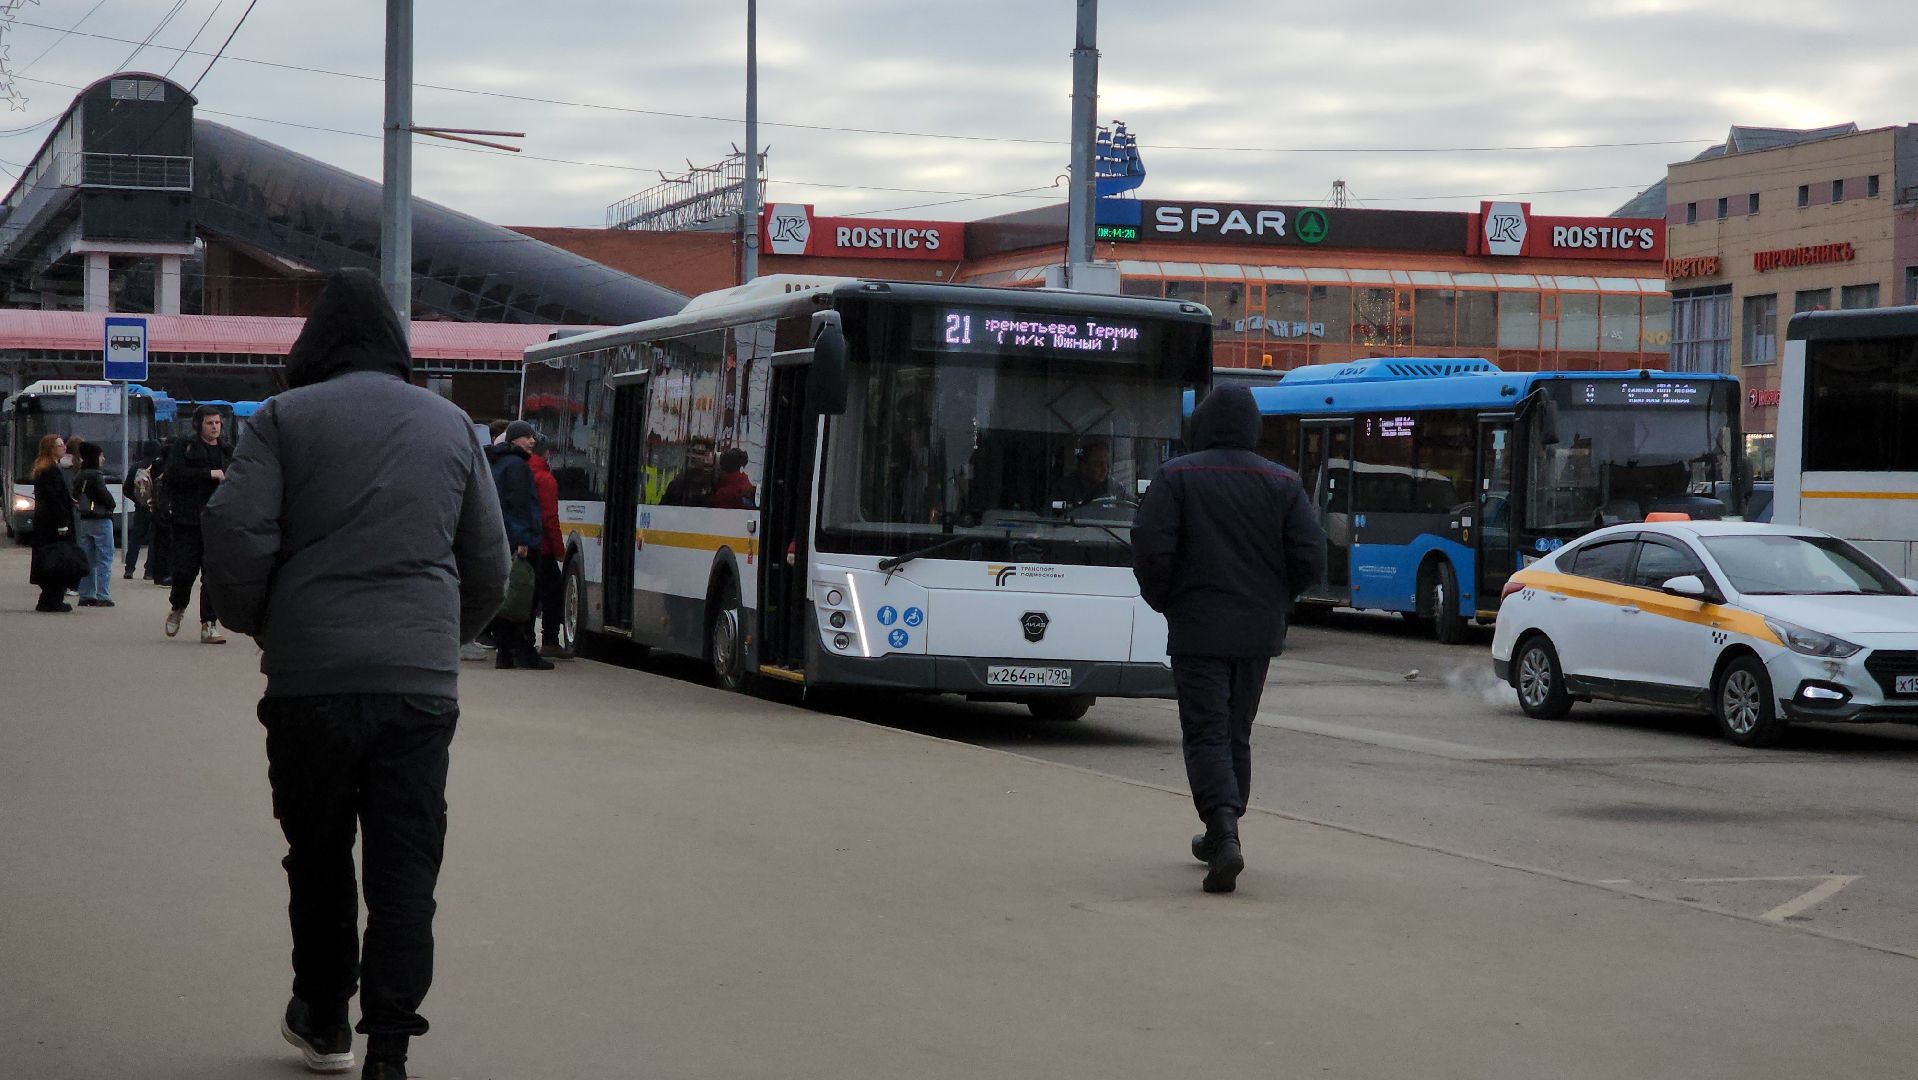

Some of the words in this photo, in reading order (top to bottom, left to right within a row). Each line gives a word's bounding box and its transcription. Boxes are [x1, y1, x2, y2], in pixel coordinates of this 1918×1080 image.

[1155, 206, 1286, 237] SPAR
[836, 226, 940, 250] ROSTIC'S
[1553, 226, 1654, 250] ROSTIC'S
[946, 314, 971, 344] 21
[1015, 334, 1045, 347] м/к
[1053, 334, 1102, 351] Южный
[1048, 669, 1068, 680] 790
